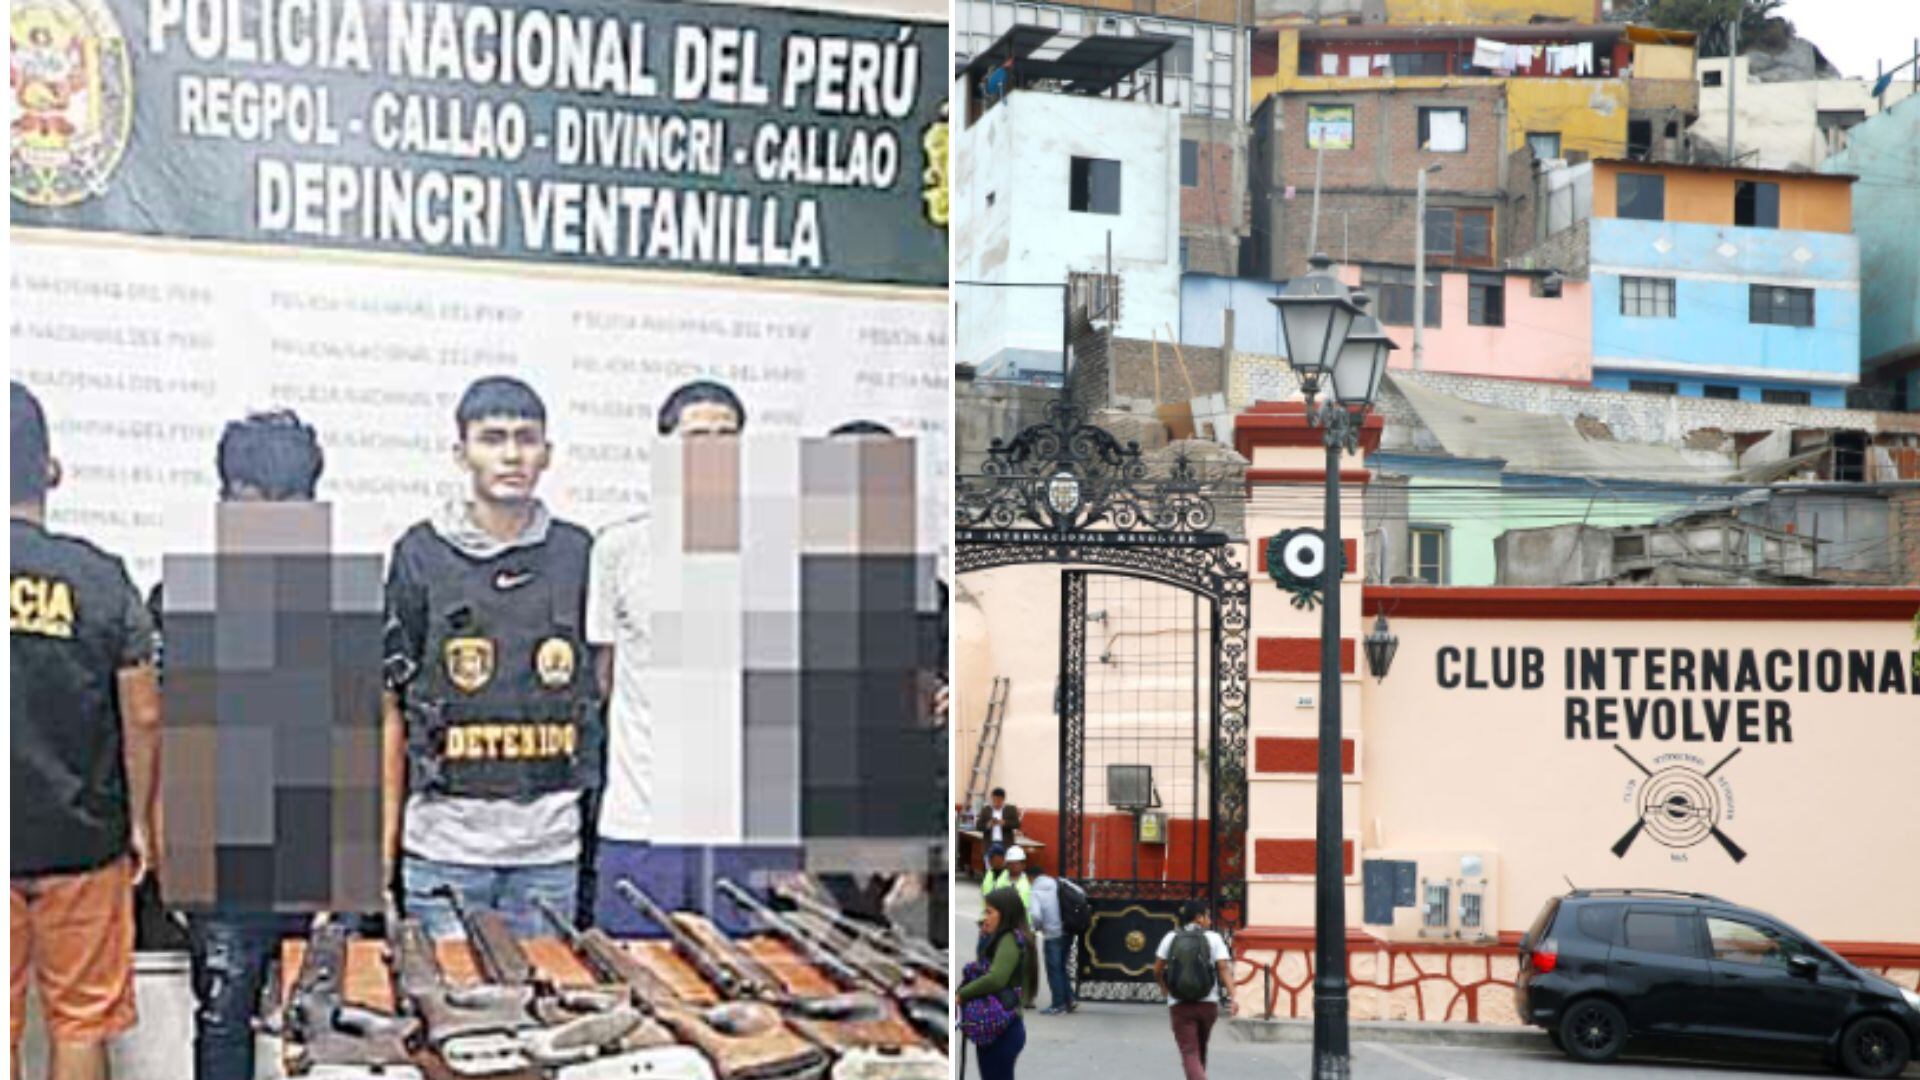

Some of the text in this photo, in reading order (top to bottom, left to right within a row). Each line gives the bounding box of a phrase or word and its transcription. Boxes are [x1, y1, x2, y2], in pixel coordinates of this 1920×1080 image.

[389, 1, 656, 97] NACIONAL
[673, 25, 769, 104] DEL
[783, 28, 919, 117] PERÚ
[179, 76, 338, 145] REGPOL
[373, 93, 525, 160] CALLAO
[557, 107, 724, 175] DIVINCRI
[755, 122, 898, 188] CALLAO
[258, 158, 820, 268] DEPINCRI VENTANILLA
[1436, 646, 1545, 689] CLUB
[1564, 697, 1793, 743] REVOLVER
